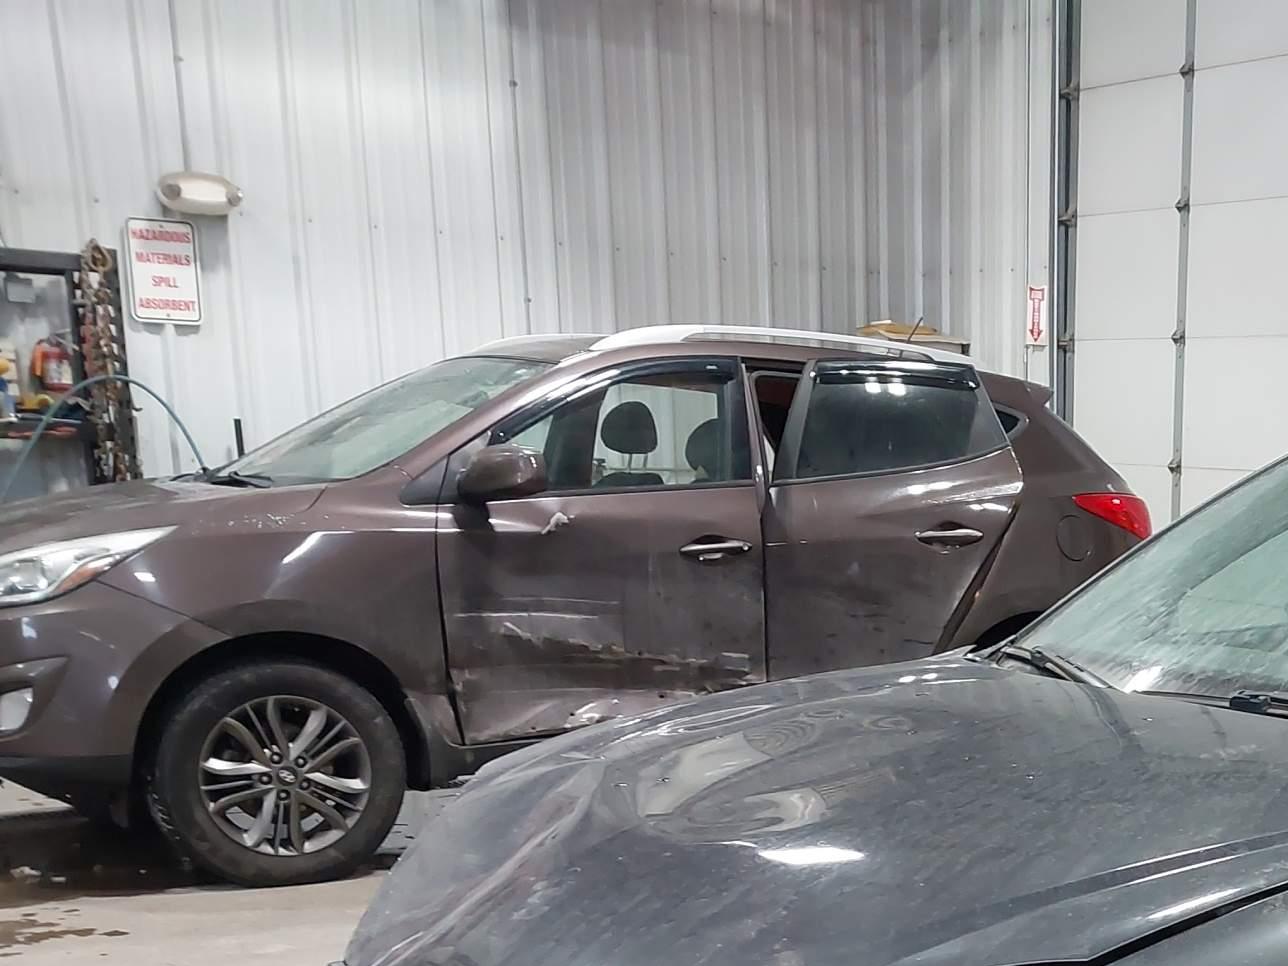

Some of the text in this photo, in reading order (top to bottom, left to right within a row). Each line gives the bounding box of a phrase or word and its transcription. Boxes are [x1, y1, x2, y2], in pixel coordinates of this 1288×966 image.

[131, 228, 191, 243] HAZARDOUS
[135, 251, 191, 266] MATERIALS
[151, 275, 179, 289] SPILL
[139, 297, 196, 312] ABSORBENT
